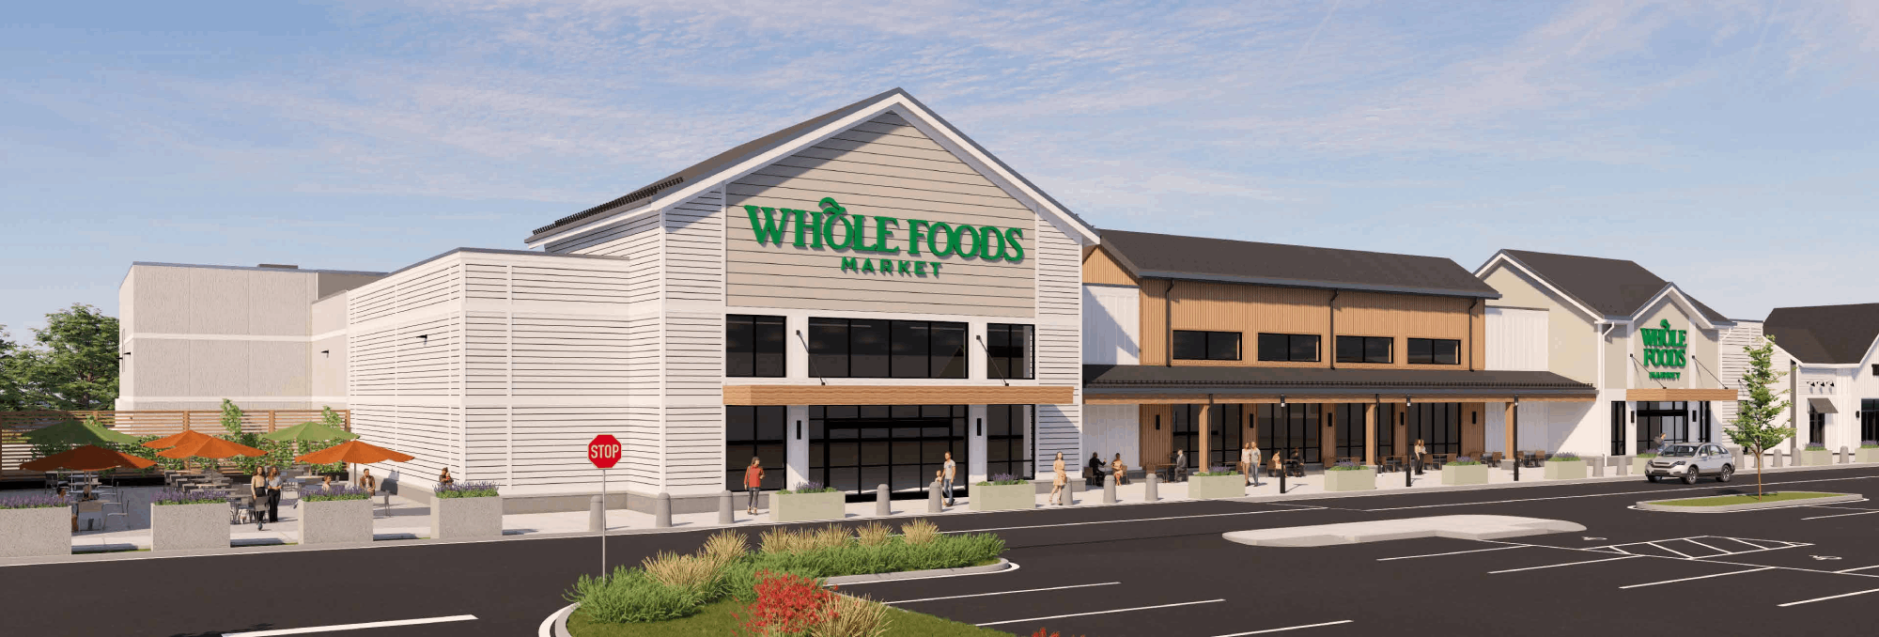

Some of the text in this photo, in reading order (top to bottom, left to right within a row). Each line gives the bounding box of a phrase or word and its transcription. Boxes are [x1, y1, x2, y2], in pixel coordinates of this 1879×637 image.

[744, 199, 1025, 262] WHOLE FOODS
[841, 256, 941, 276] MARKET
[1640, 324, 1687, 347] WHOLE
[1643, 348, 1687, 367] FOODS
[590, 444, 619, 459] STOP
